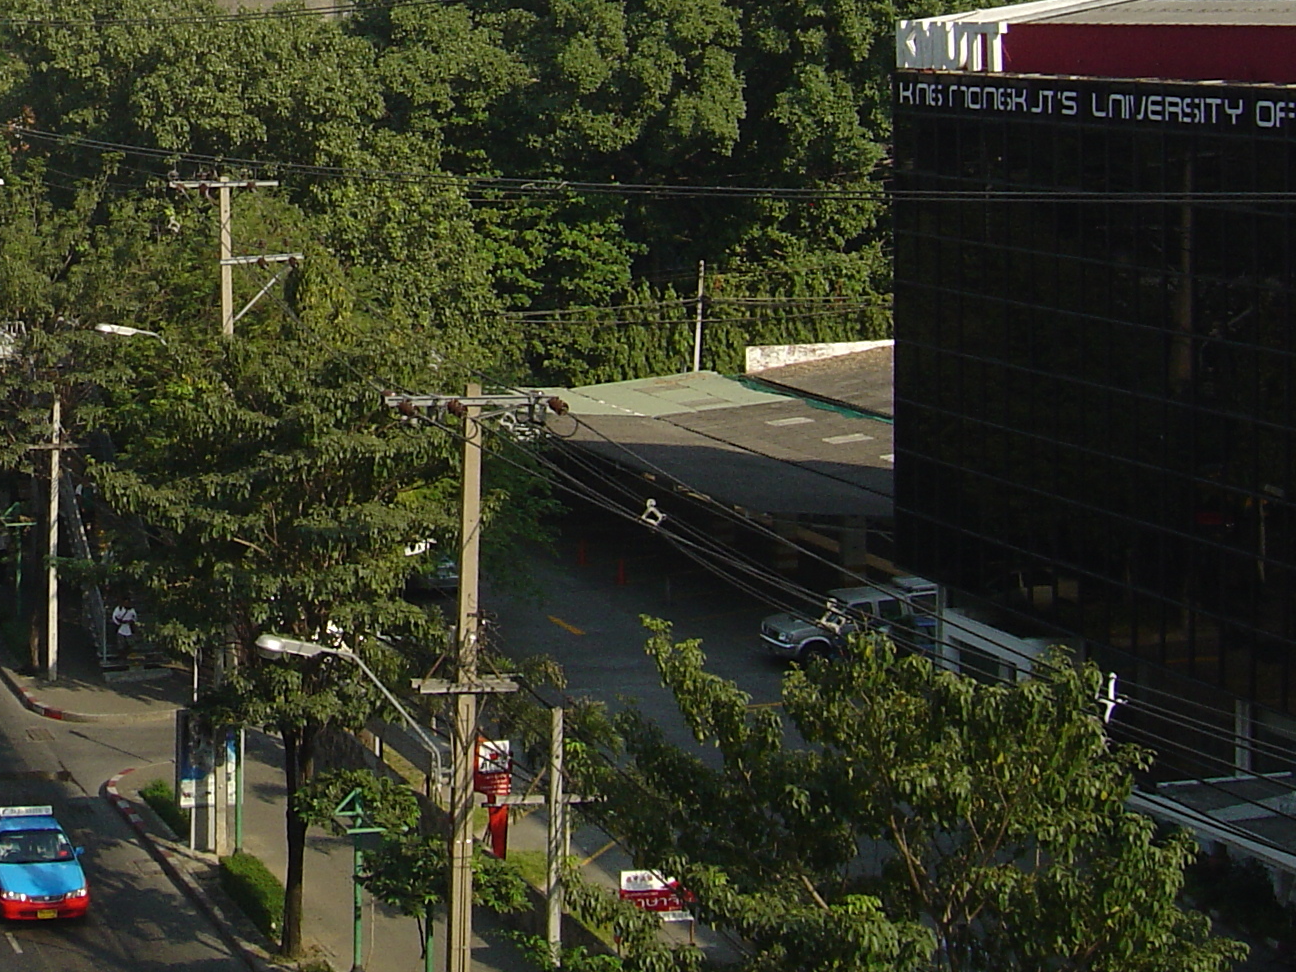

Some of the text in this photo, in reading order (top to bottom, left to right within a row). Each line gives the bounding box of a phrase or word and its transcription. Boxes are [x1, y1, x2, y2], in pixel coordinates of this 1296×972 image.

[896, 20, 1007, 72] KMUTT
[899, 82, 943, 107] KNG
[1092, 93, 1243, 125] UNIVERSITY
